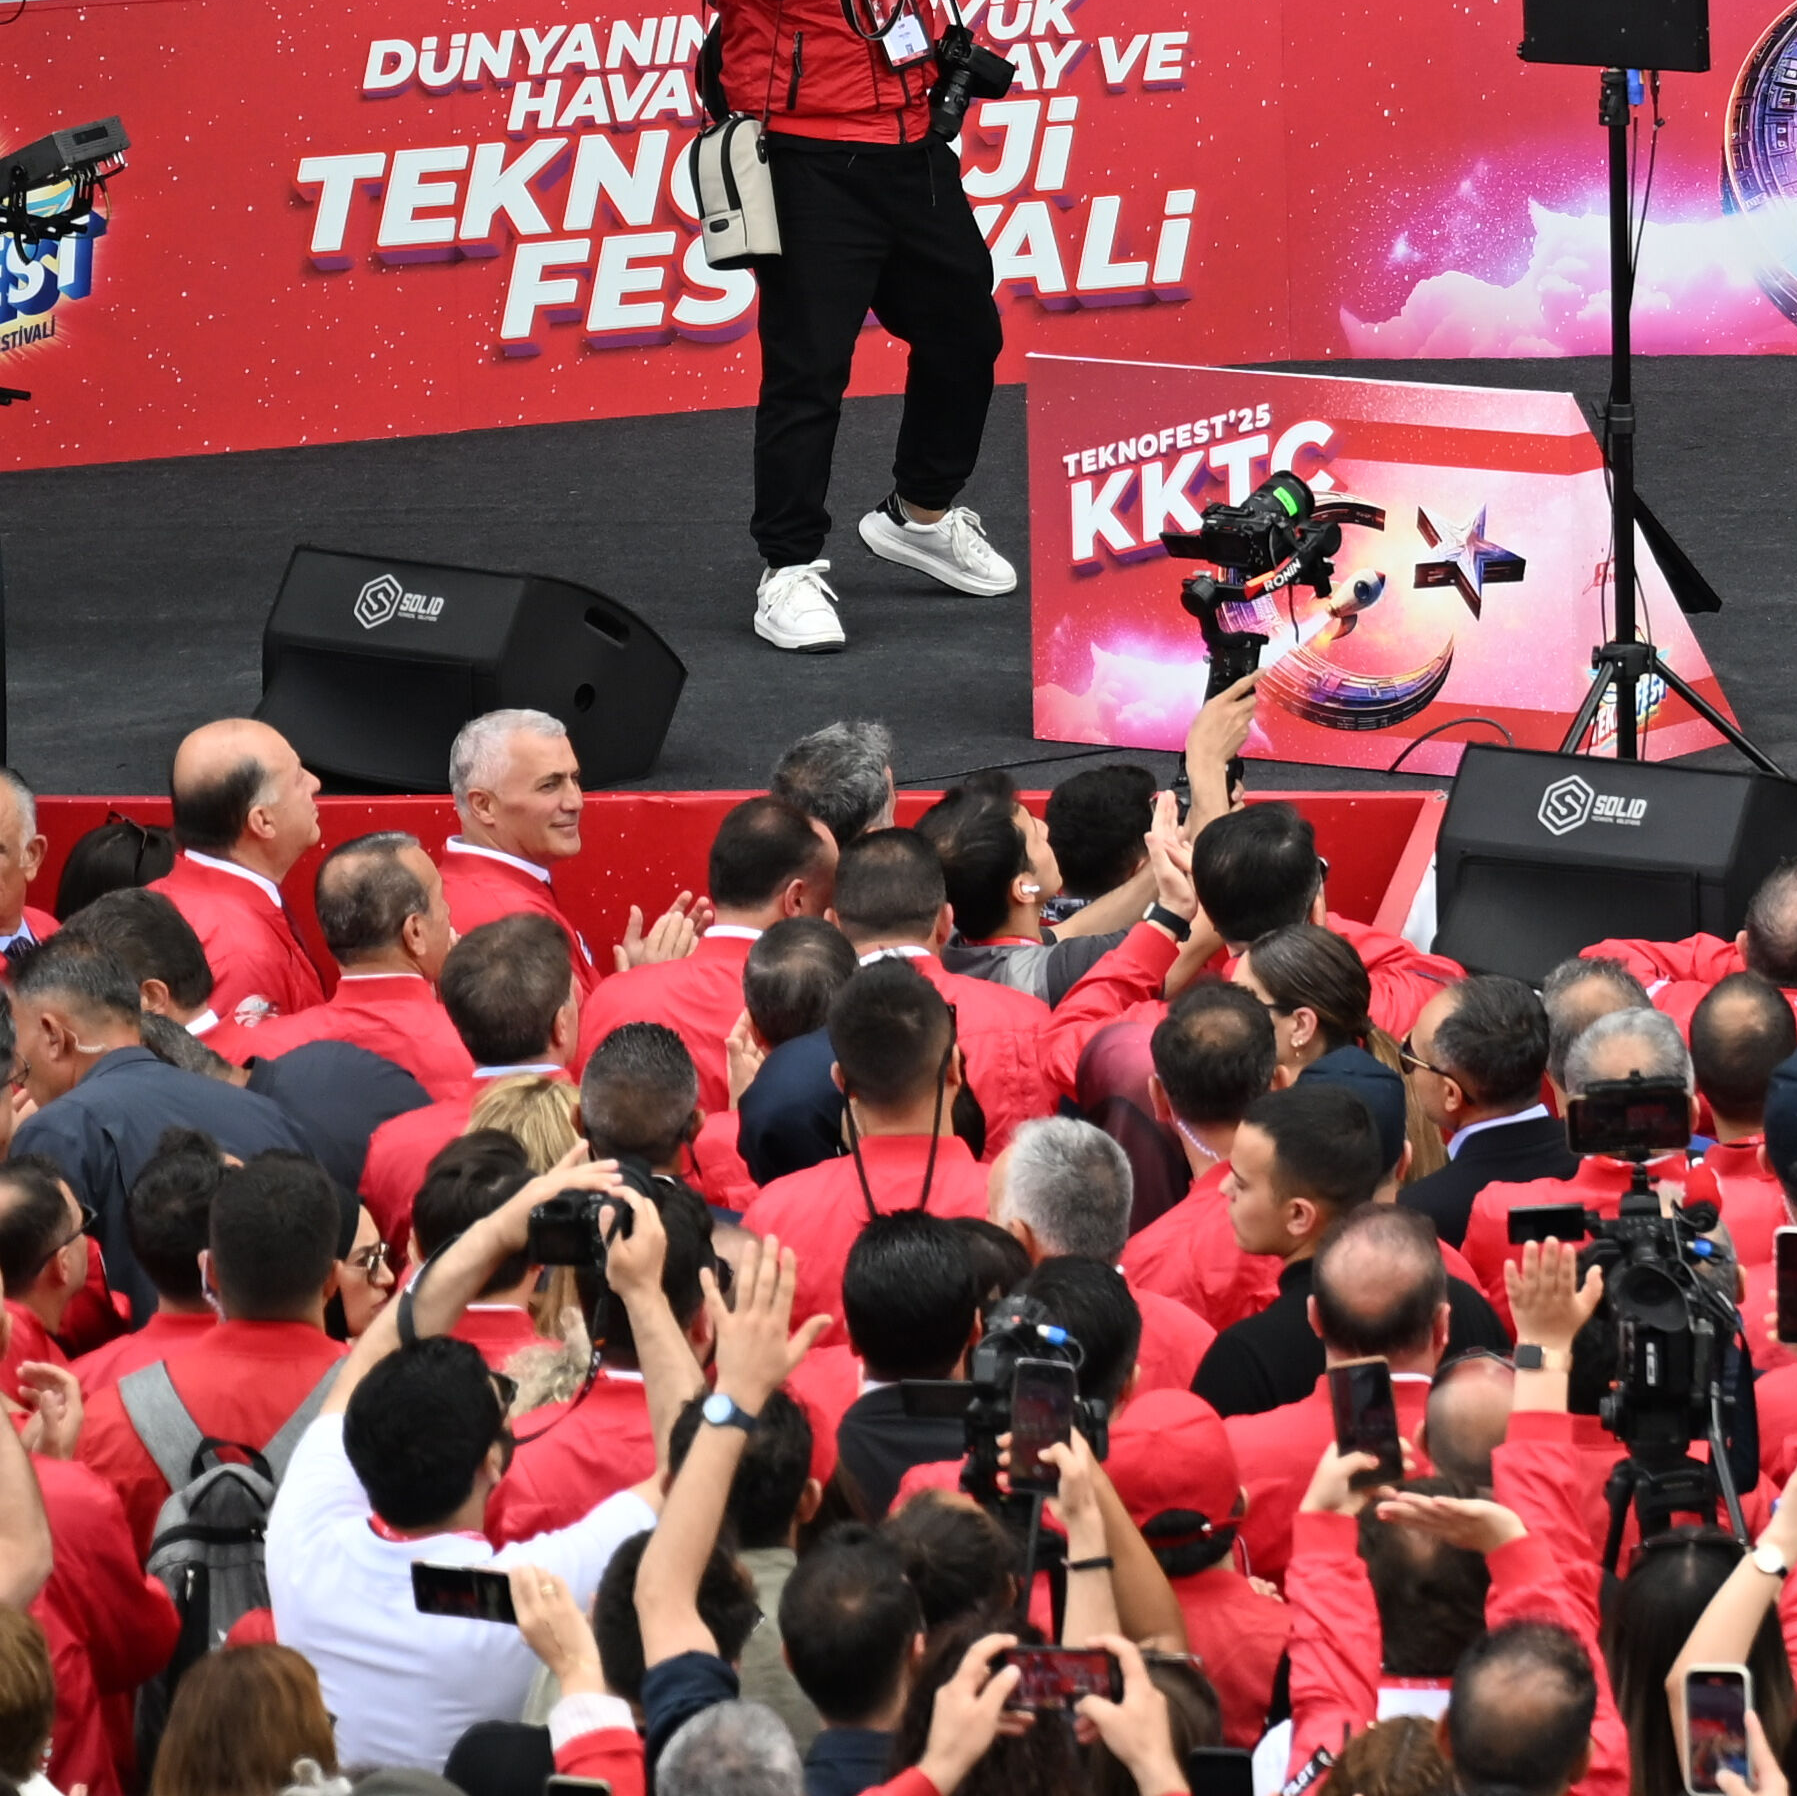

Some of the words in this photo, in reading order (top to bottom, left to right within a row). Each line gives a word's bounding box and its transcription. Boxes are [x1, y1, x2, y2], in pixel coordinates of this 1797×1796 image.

[361, 14, 719, 92] DÜNYANIN
[1097, 31, 1189, 84] VE
[0, 314, 56, 352] STİVALİ
[1062, 403, 1271, 478] TEKNOFEST'25
[1264, 557, 1302, 592] RONIN
[399, 592, 445, 616] SOLID
[1592, 794, 1648, 819] SOLID
